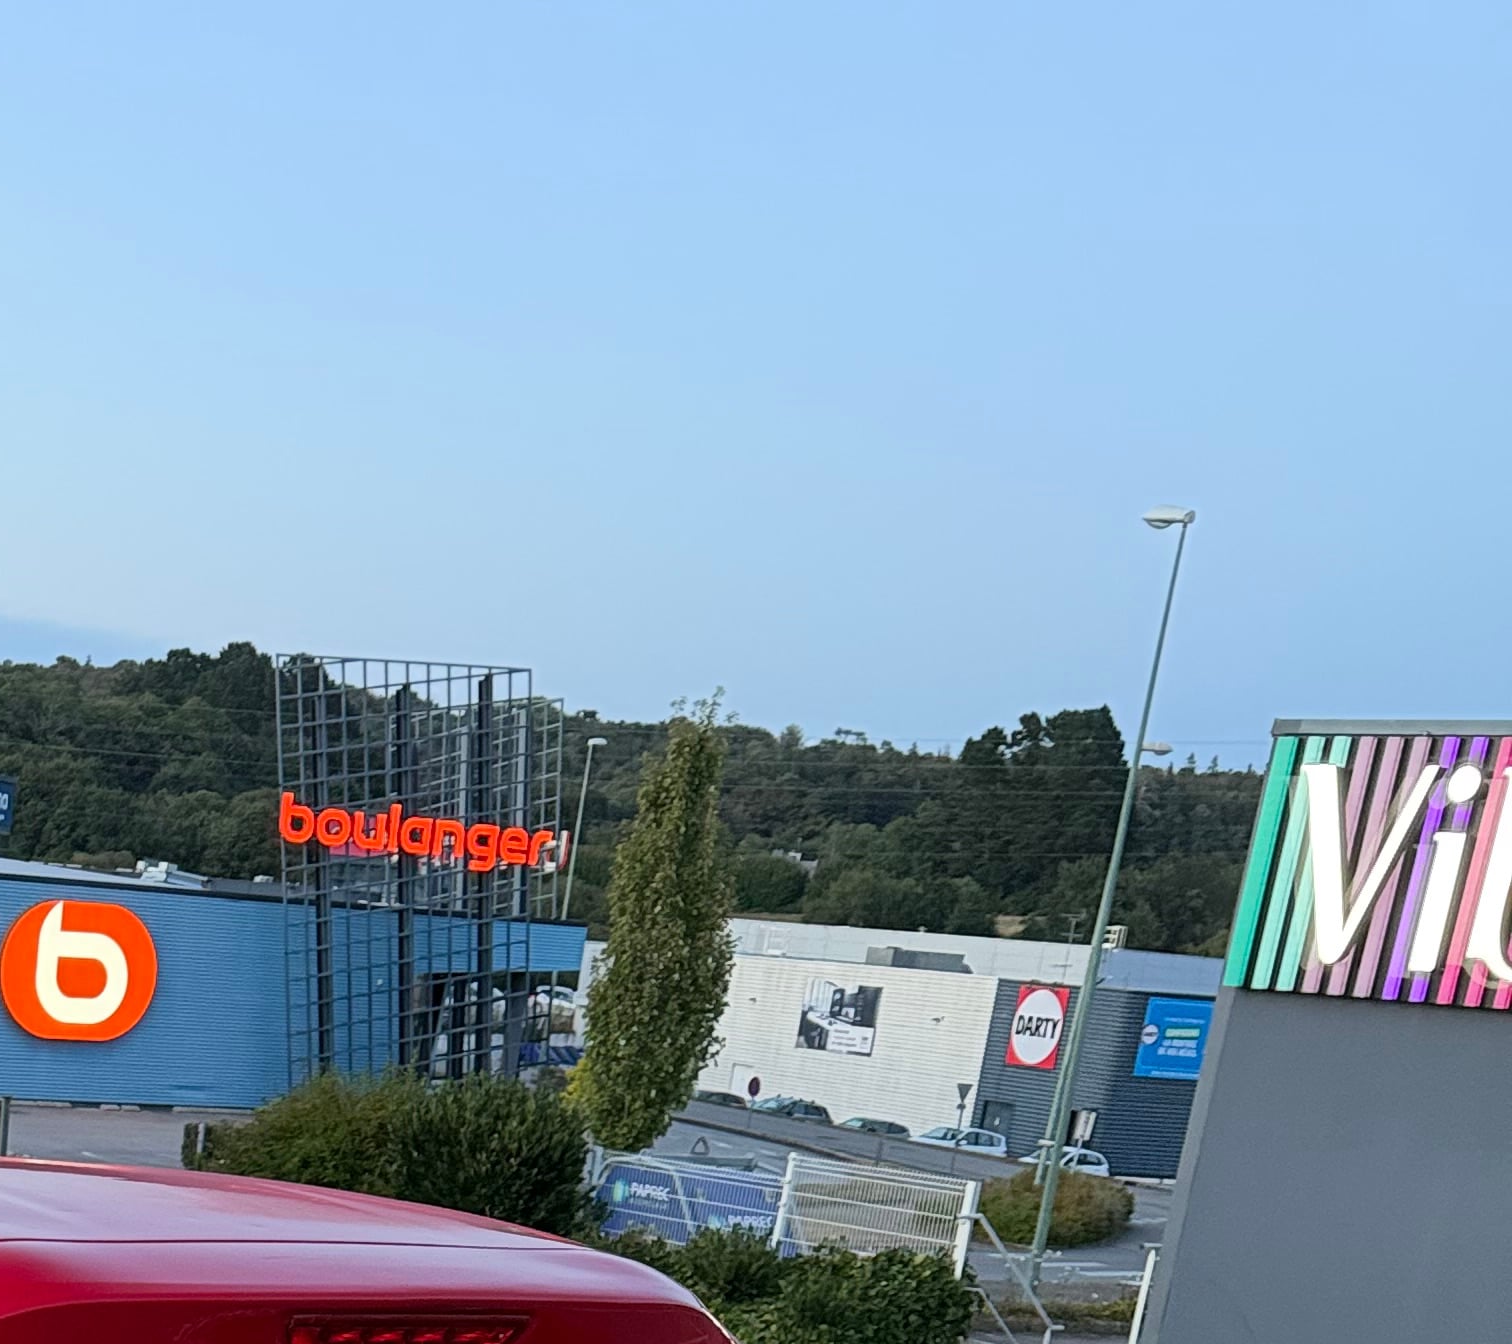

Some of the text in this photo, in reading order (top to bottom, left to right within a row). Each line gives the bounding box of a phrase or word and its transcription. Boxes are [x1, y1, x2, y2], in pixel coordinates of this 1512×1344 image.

[278, 791, 553, 872] boulanger
[35, 900, 128, 1025] b
[1015, 1014, 1061, 1040] DARTY
